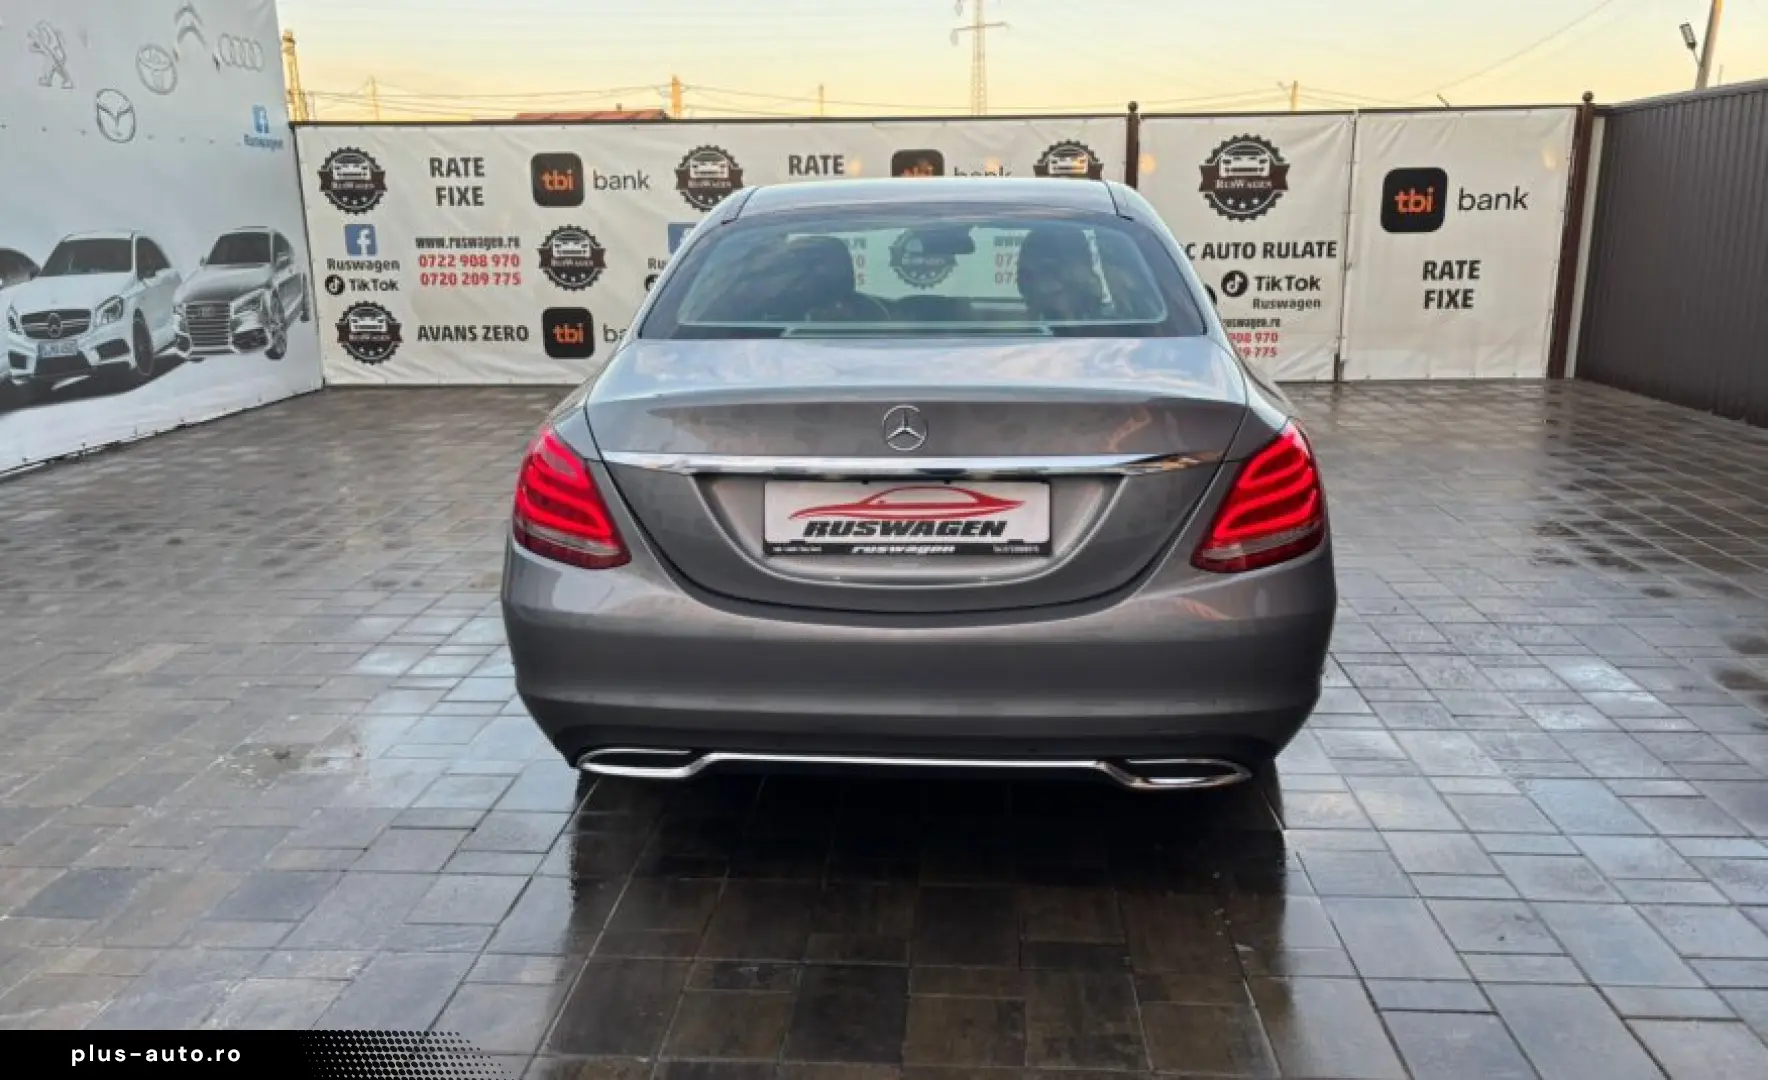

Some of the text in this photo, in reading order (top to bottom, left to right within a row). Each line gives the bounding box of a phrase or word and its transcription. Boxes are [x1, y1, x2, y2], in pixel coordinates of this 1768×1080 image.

[430, 156, 485, 177] RATE
[788, 155, 844, 176] RATE
[541, 170, 650, 191] tbi bank
[435, 186, 485, 207] FIXE
[1394, 186, 1529, 213] tbi bank
[1202, 242, 1256, 260] AUTO
[1262, 240, 1337, 259] RULATE
[326, 258, 400, 273] Ruswagen
[419, 254, 520, 267] 0722 908 970
[420, 272, 521, 286] 0720 209 775
[1422, 260, 1481, 280] RATE
[348, 277, 399, 292] TikTok
[1254, 274, 1321, 292] TikTok
[1253, 298, 1321, 311] Ruswagen
[1423, 288, 1475, 310] FIXE
[417, 325, 530, 342] AVANS ZERO
[553, 323, 584, 344] tbi
[1255, 332, 1278, 343] 970
[1255, 346, 1277, 358] 775
[803, 520, 1008, 538] RUSWAGEN
